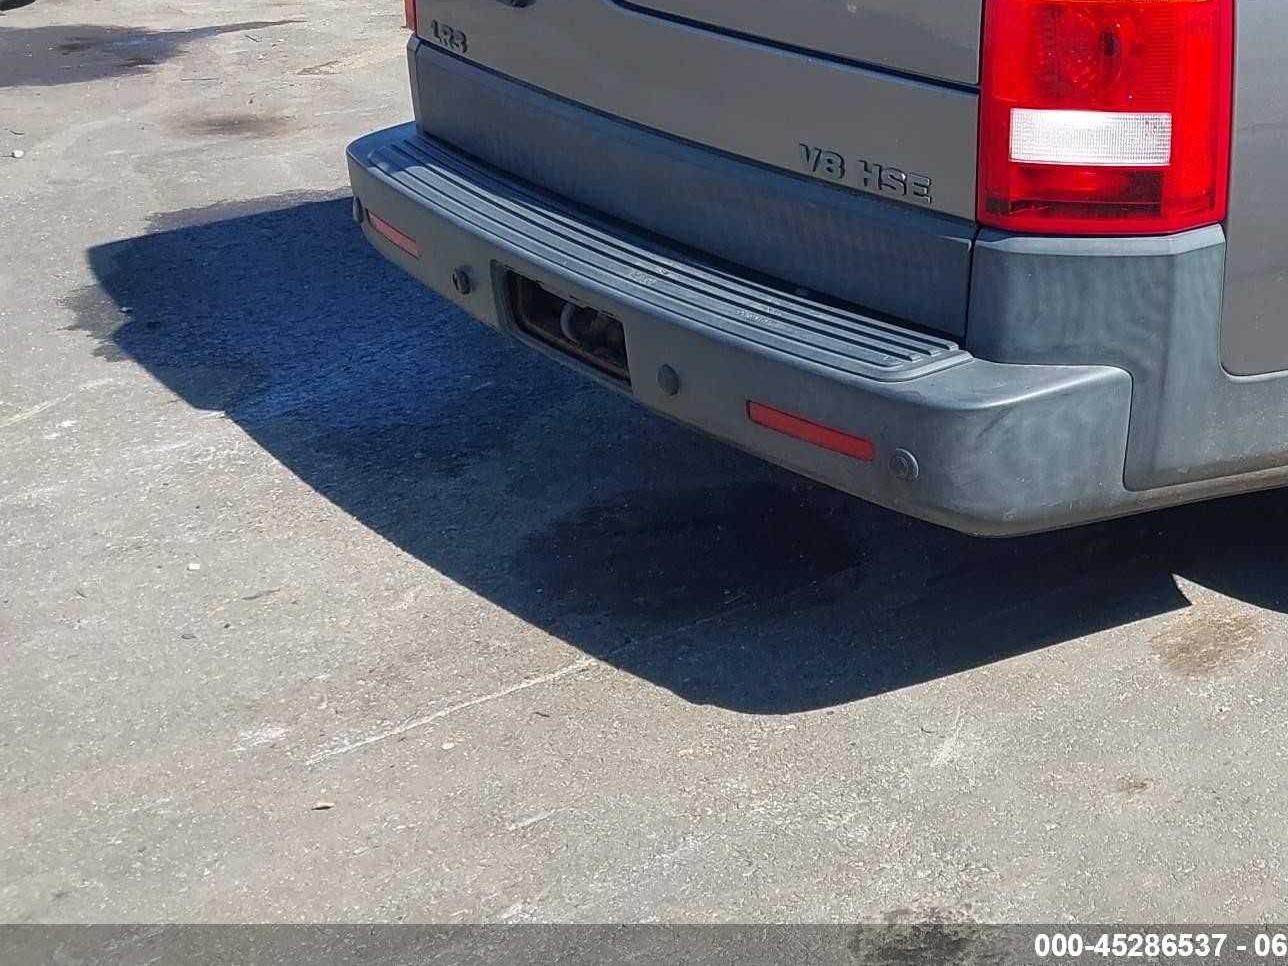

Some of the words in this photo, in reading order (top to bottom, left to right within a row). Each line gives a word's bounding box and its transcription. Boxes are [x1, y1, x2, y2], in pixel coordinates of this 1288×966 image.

[430, 19, 468, 54] LR3
[799, 143, 846, 179] V8
[857, 159, 933, 205] HSE
